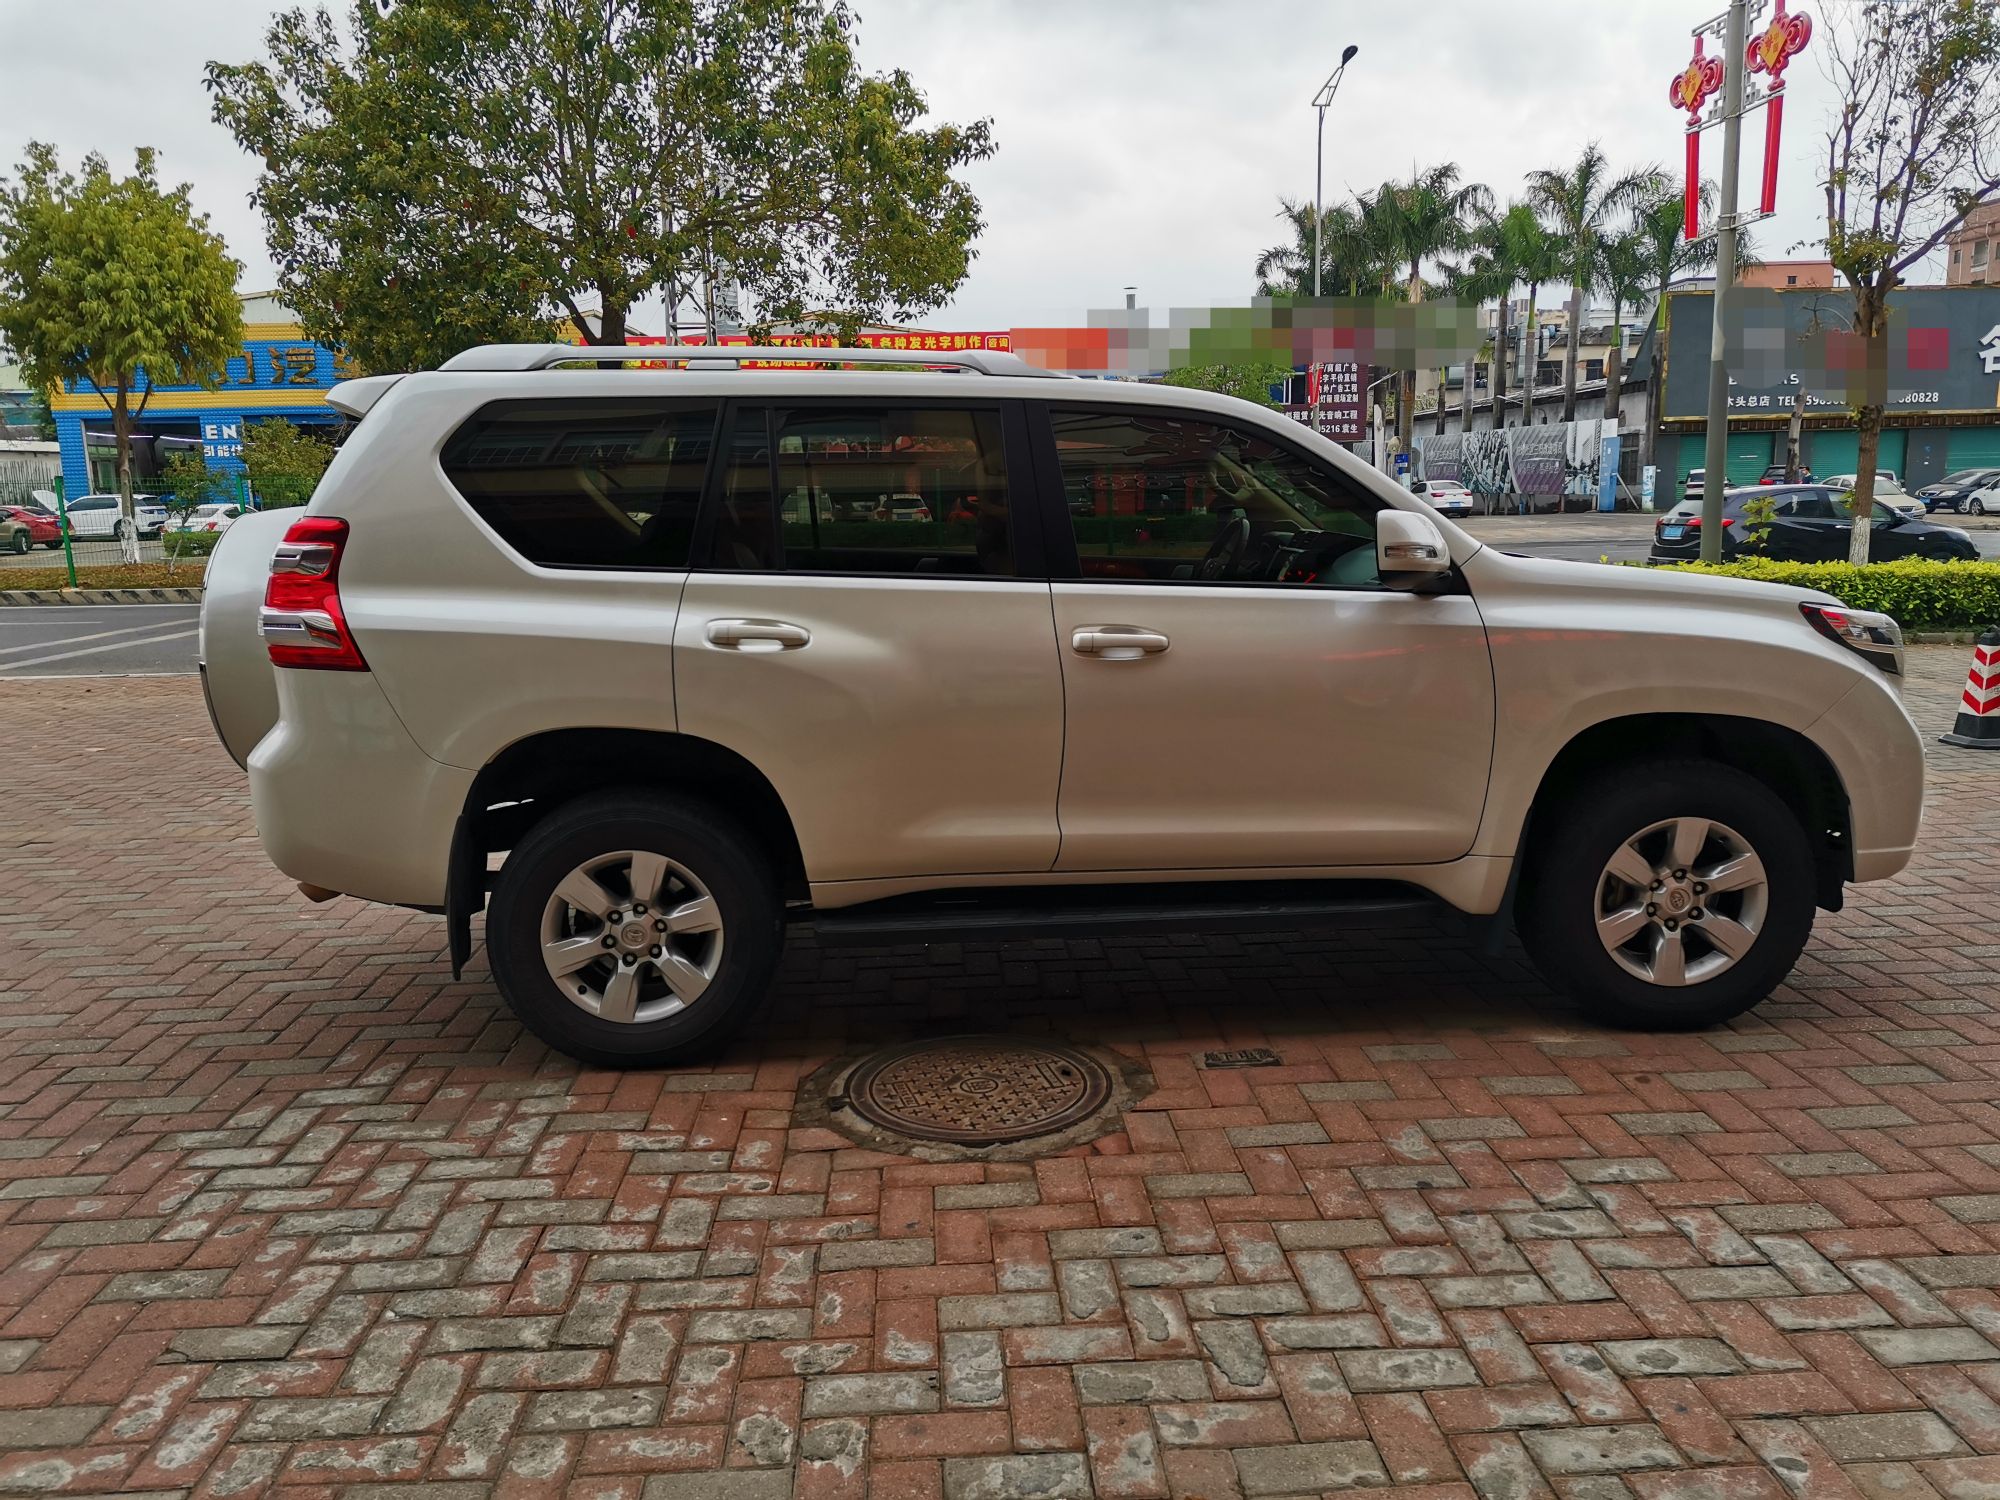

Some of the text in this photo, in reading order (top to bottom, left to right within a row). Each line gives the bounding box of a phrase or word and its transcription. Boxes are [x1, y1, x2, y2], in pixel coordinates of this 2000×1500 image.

[879, 335, 1009, 350] 各种发光字制作 咨询
